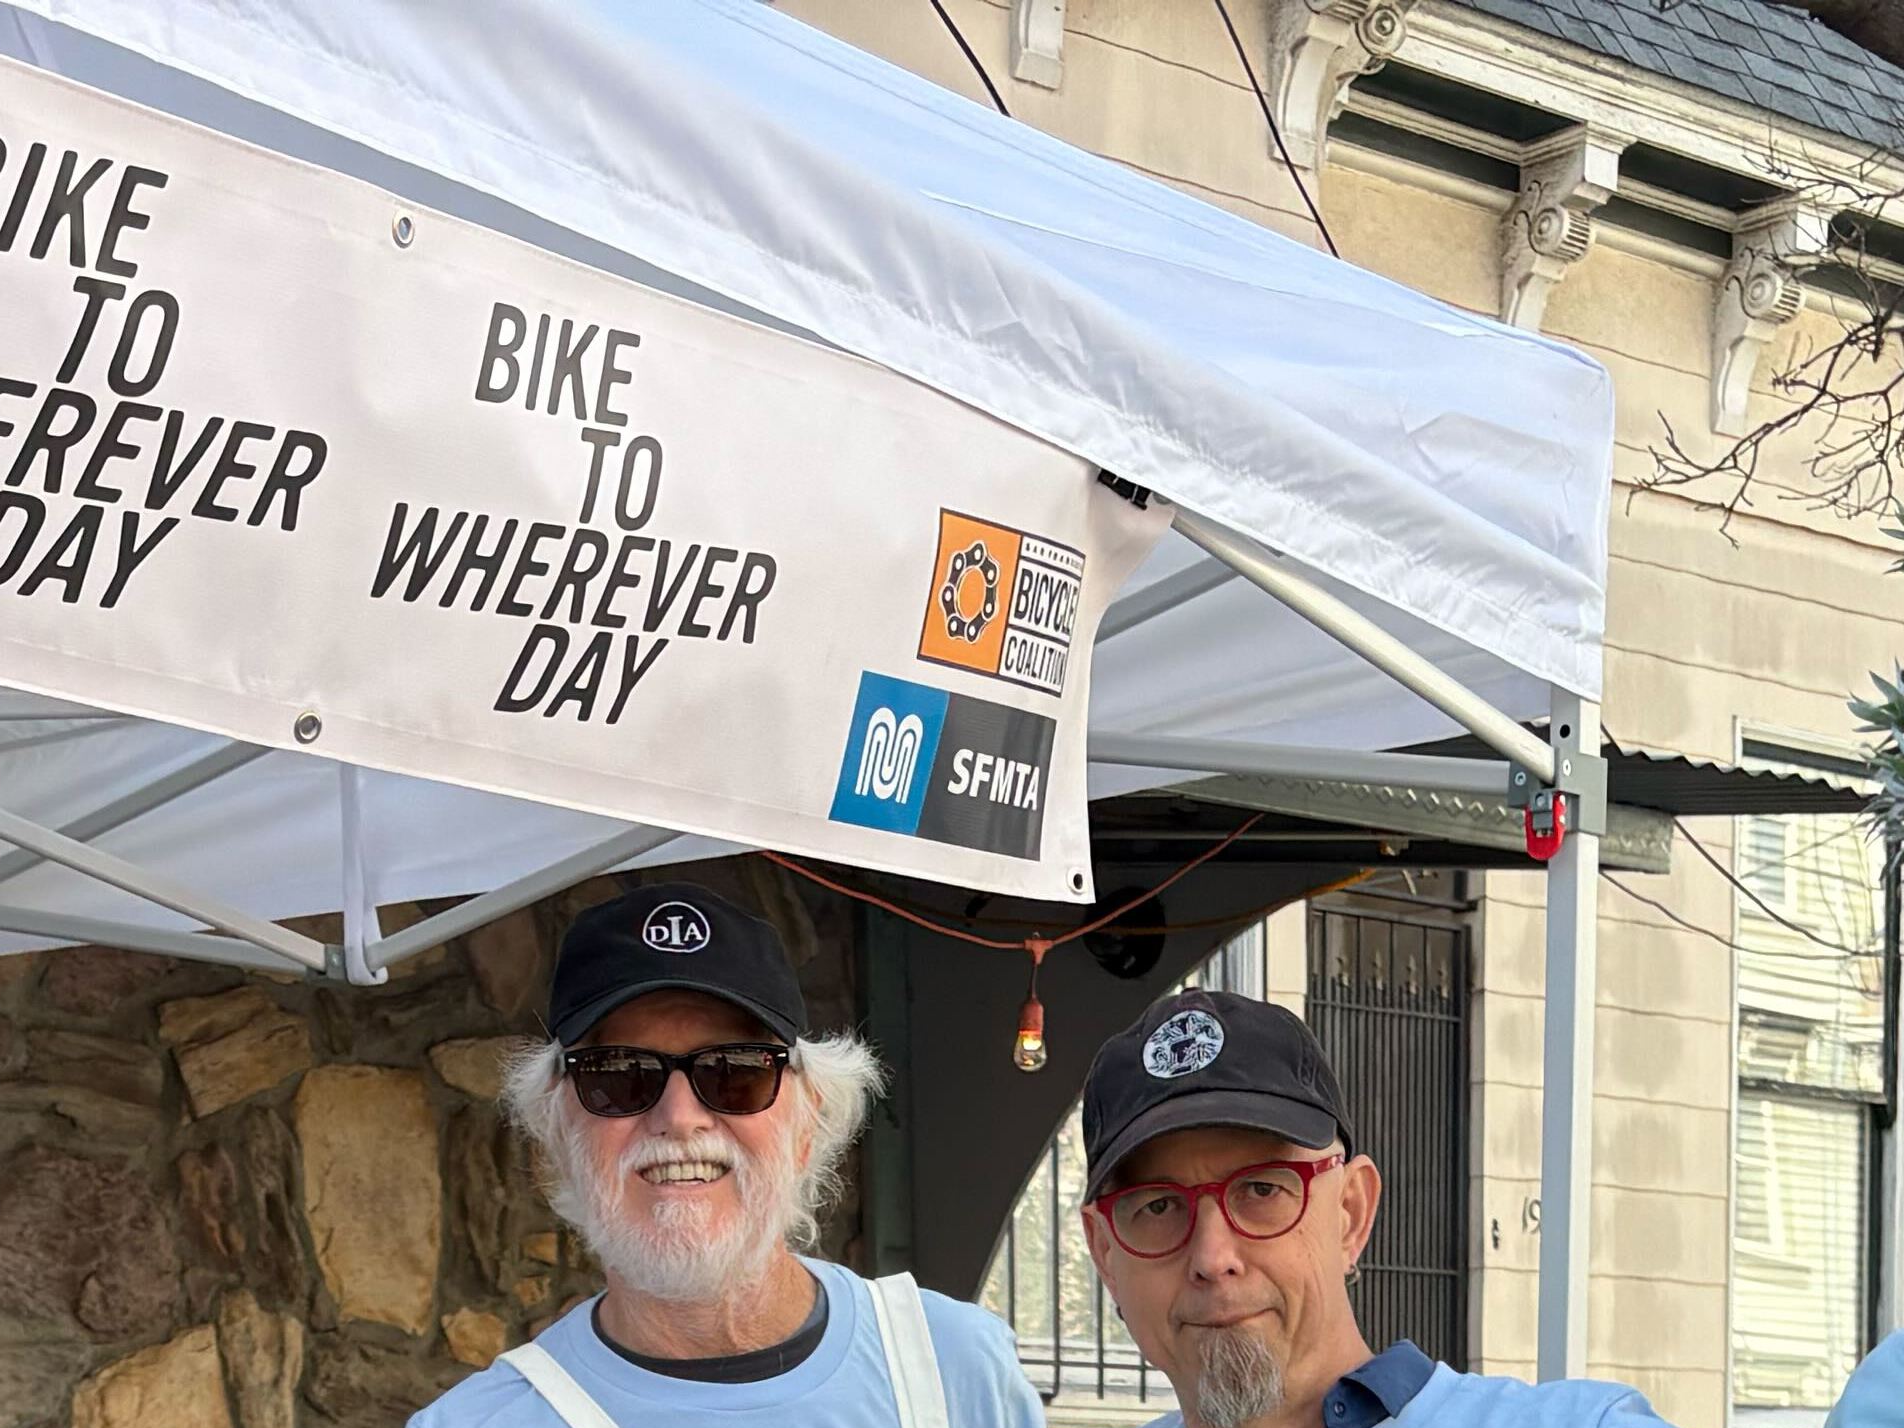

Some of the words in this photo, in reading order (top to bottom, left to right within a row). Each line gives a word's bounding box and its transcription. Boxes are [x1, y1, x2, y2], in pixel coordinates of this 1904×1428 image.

[56, 276, 179, 397] TO
[476, 303, 640, 426] BIKE
[580, 427, 662, 530] TO
[371, 503, 776, 643] WHEREVER
[1014, 567, 1078, 636] BICYCLE
[494, 624, 669, 724] DAY
[948, 748, 1040, 811] SFMTA
[648, 915, 704, 945] DIA
